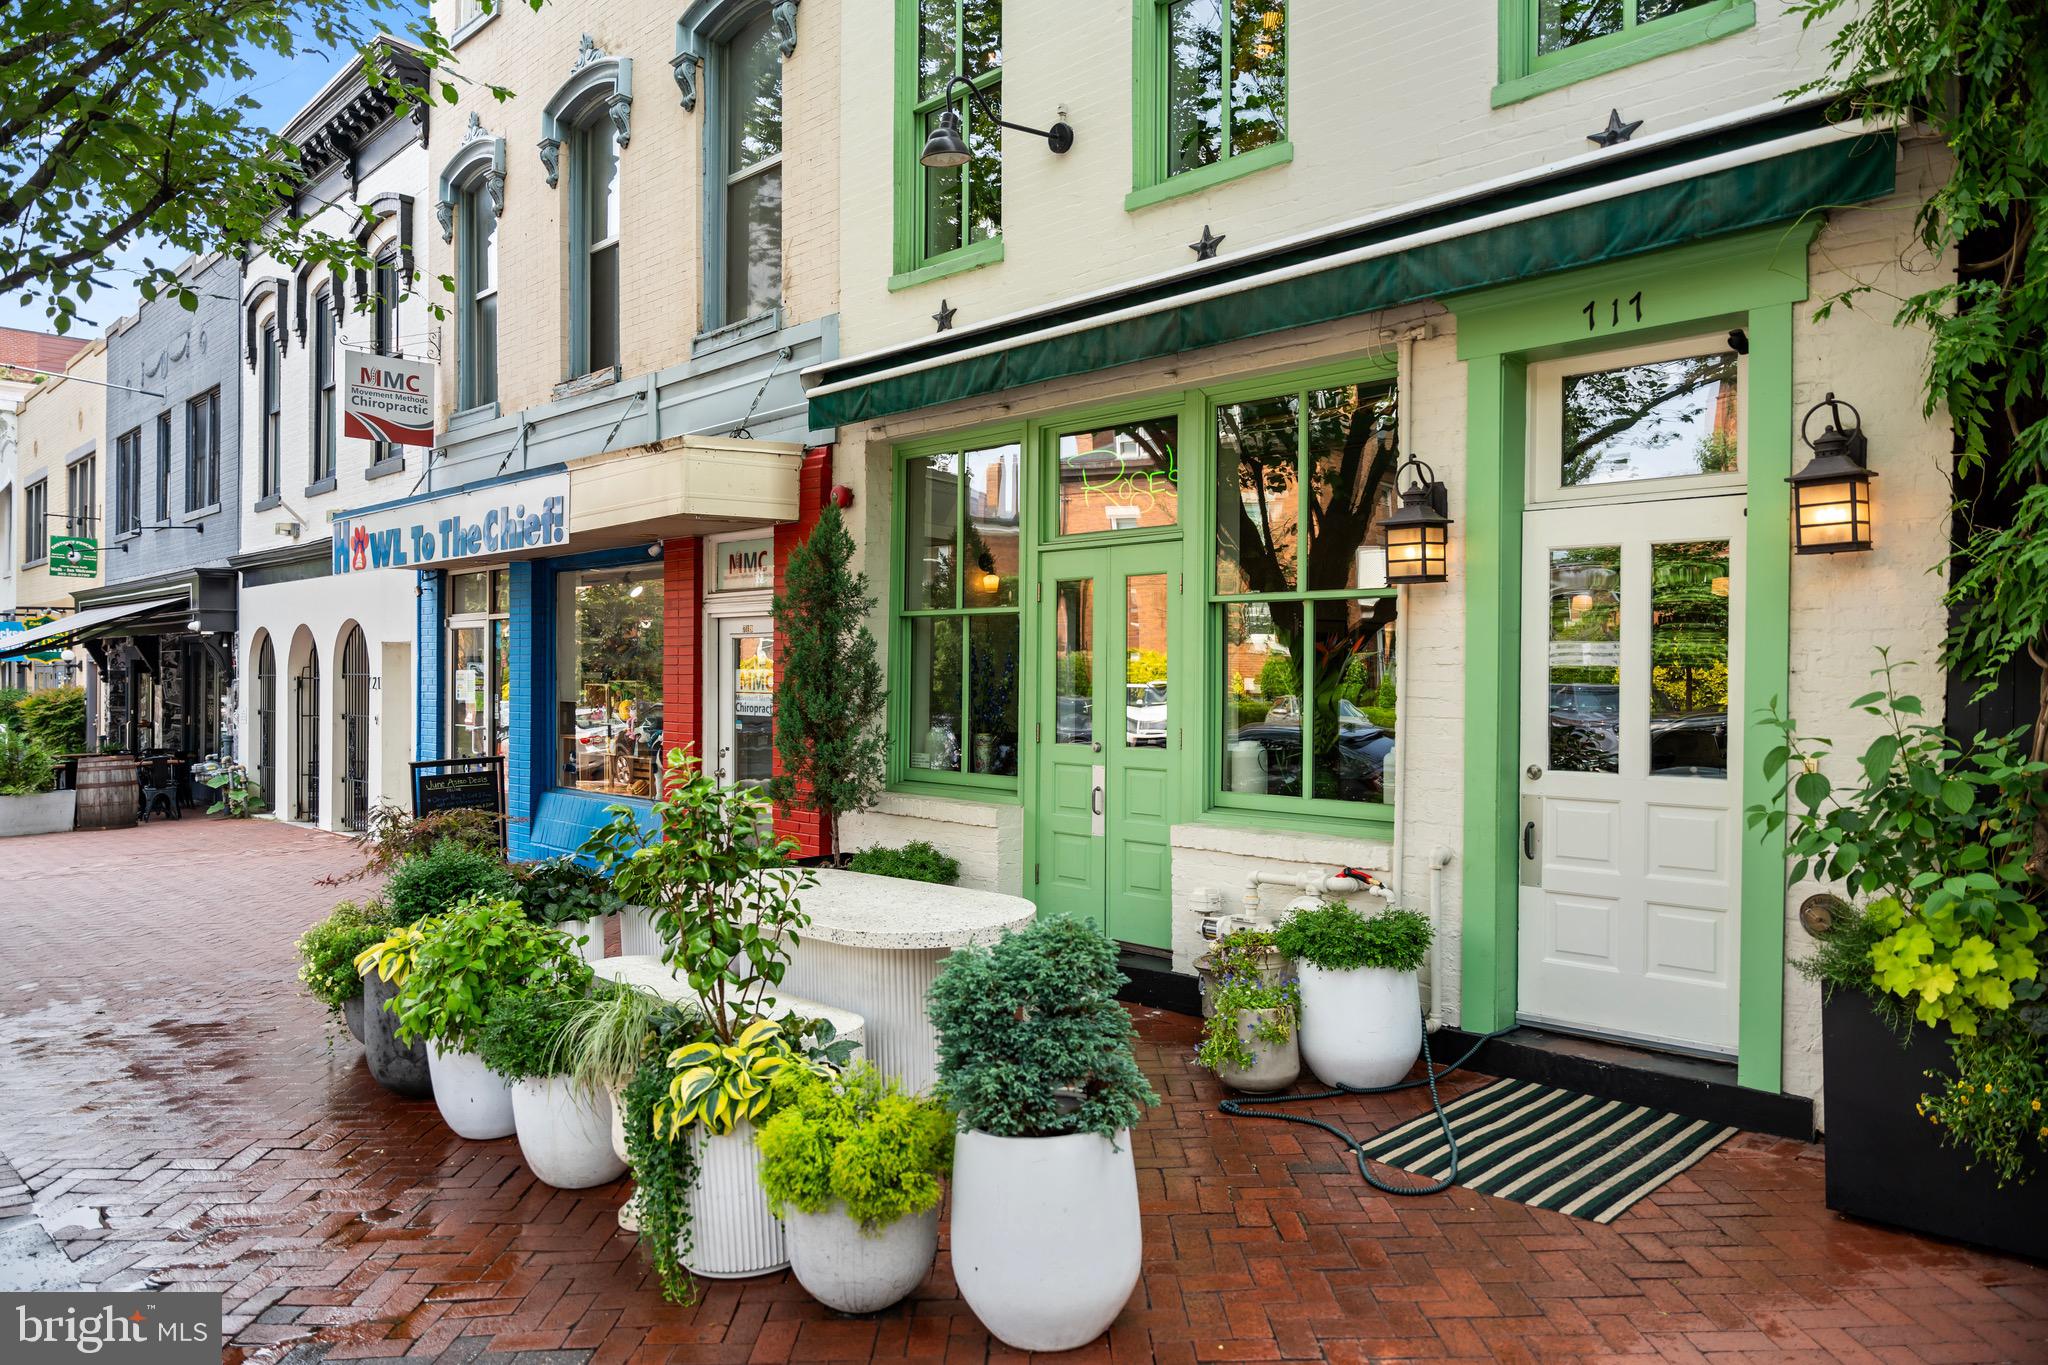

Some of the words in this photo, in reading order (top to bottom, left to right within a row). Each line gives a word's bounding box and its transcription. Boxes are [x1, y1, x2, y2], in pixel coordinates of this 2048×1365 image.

[360, 367, 420, 393] MMC
[351, 387, 393, 400] Movement
[395, 393, 428, 405] Methods
[351, 395, 429, 415] Chiropractic
[729, 550, 768, 574] MMC
